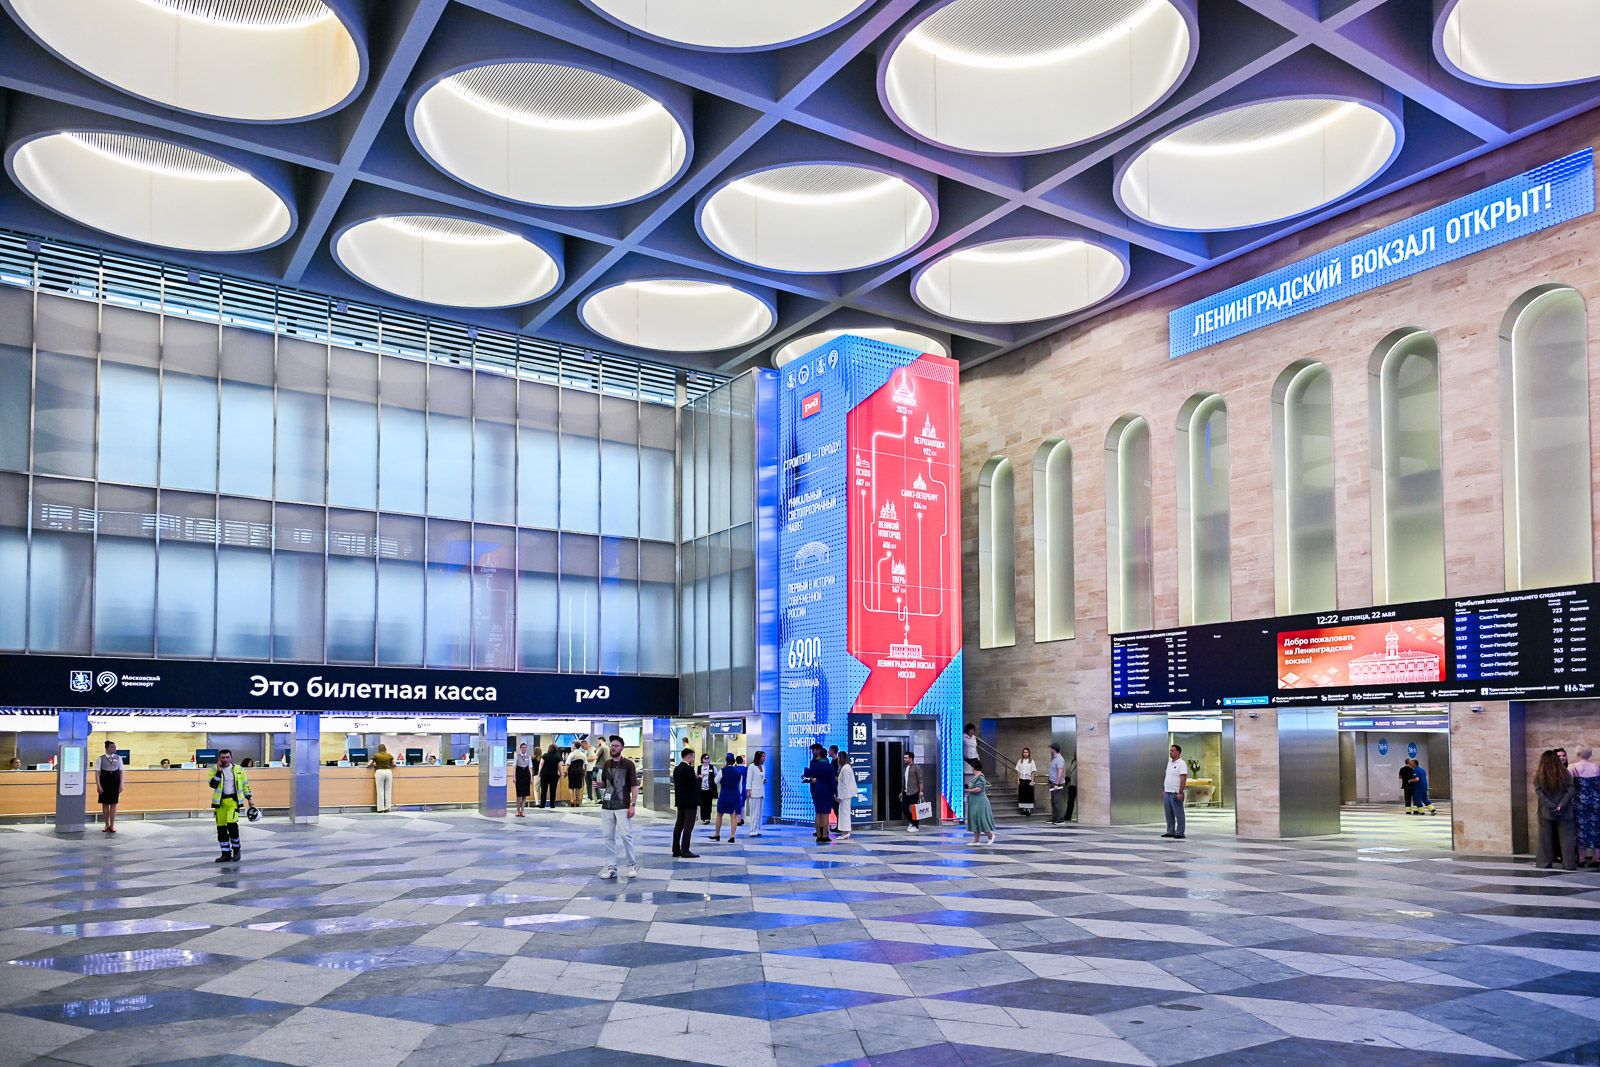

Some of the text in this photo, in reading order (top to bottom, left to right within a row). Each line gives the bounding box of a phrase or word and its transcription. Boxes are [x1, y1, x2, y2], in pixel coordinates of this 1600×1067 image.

[1193, 182, 1552, 338] ЛЕНИНГРАДСКИЙ ВОКЗАЛ ОТКРЫТ!
[784, 452, 812, 472] СТРОИТЕЛИ
[788, 486, 823, 509] УНИКАЛЬНЫЙ
[901, 489, 939, 502] САНКТ-ПЕТЕРБУРГ
[788, 496, 837, 521] СВЕТОПРОЗРАЧНЫЙ
[788, 520, 804, 533] НАВЕС
[878, 520, 900, 531] ВЕЛИКИЙ
[878, 530, 901, 540] НОВГОРОД
[788, 574, 836, 594] ПЕРВЫЙ В ИСТОРИИ
[892, 575, 906, 584] ТВЕРЬ
[788, 589, 822, 606] СОВРЕМЕННОЙ
[1455, 599, 1485, 608] Прибытие
[1510, 594, 1538, 602] дальнего
[1539, 590, 1577, 599] следования
[788, 606, 807, 619] РОССИИ
[1316, 615, 1338, 625] 12:22
[1341, 613, 1371, 623] пятница,
[1371, 611, 1381, 619] 22
[1479, 612, 1518, 621] Санкт-Петербург
[1480, 622, 1518, 630] Санкт-Петербург
[1284, 634, 1356, 647] Добро пожаловать
[1480, 632, 1518, 640] Санкт-Петербург
[1294, 643, 1353, 656] Ленинградский
[1480, 641, 1518, 649] Санкт-Петербург
[788, 636, 821, 669] 6900
[1480, 651, 1519, 659] Санкт-Петербург
[877, 659, 935, 669] ЛЕНИНГРАДСКИЙ ВОКЗАЛ
[1284, 656, 1313, 665] вокзал!
[1481, 660, 1519, 668] Санкт-Петербург
[122, 674, 160, 682] Московский
[898, 671, 916, 679] МОСКВА
[1481, 670, 1519, 678] Санкт-Петербург
[250, 675, 497, 701] Это билетная касса
[788, 711, 816, 722] ОТСУТСТВИЕ
[788, 723, 831, 735] ПОВТОРЯЮЩИХСЯ
[788, 737, 816, 748] ЭЛЕМЕНТОВ
